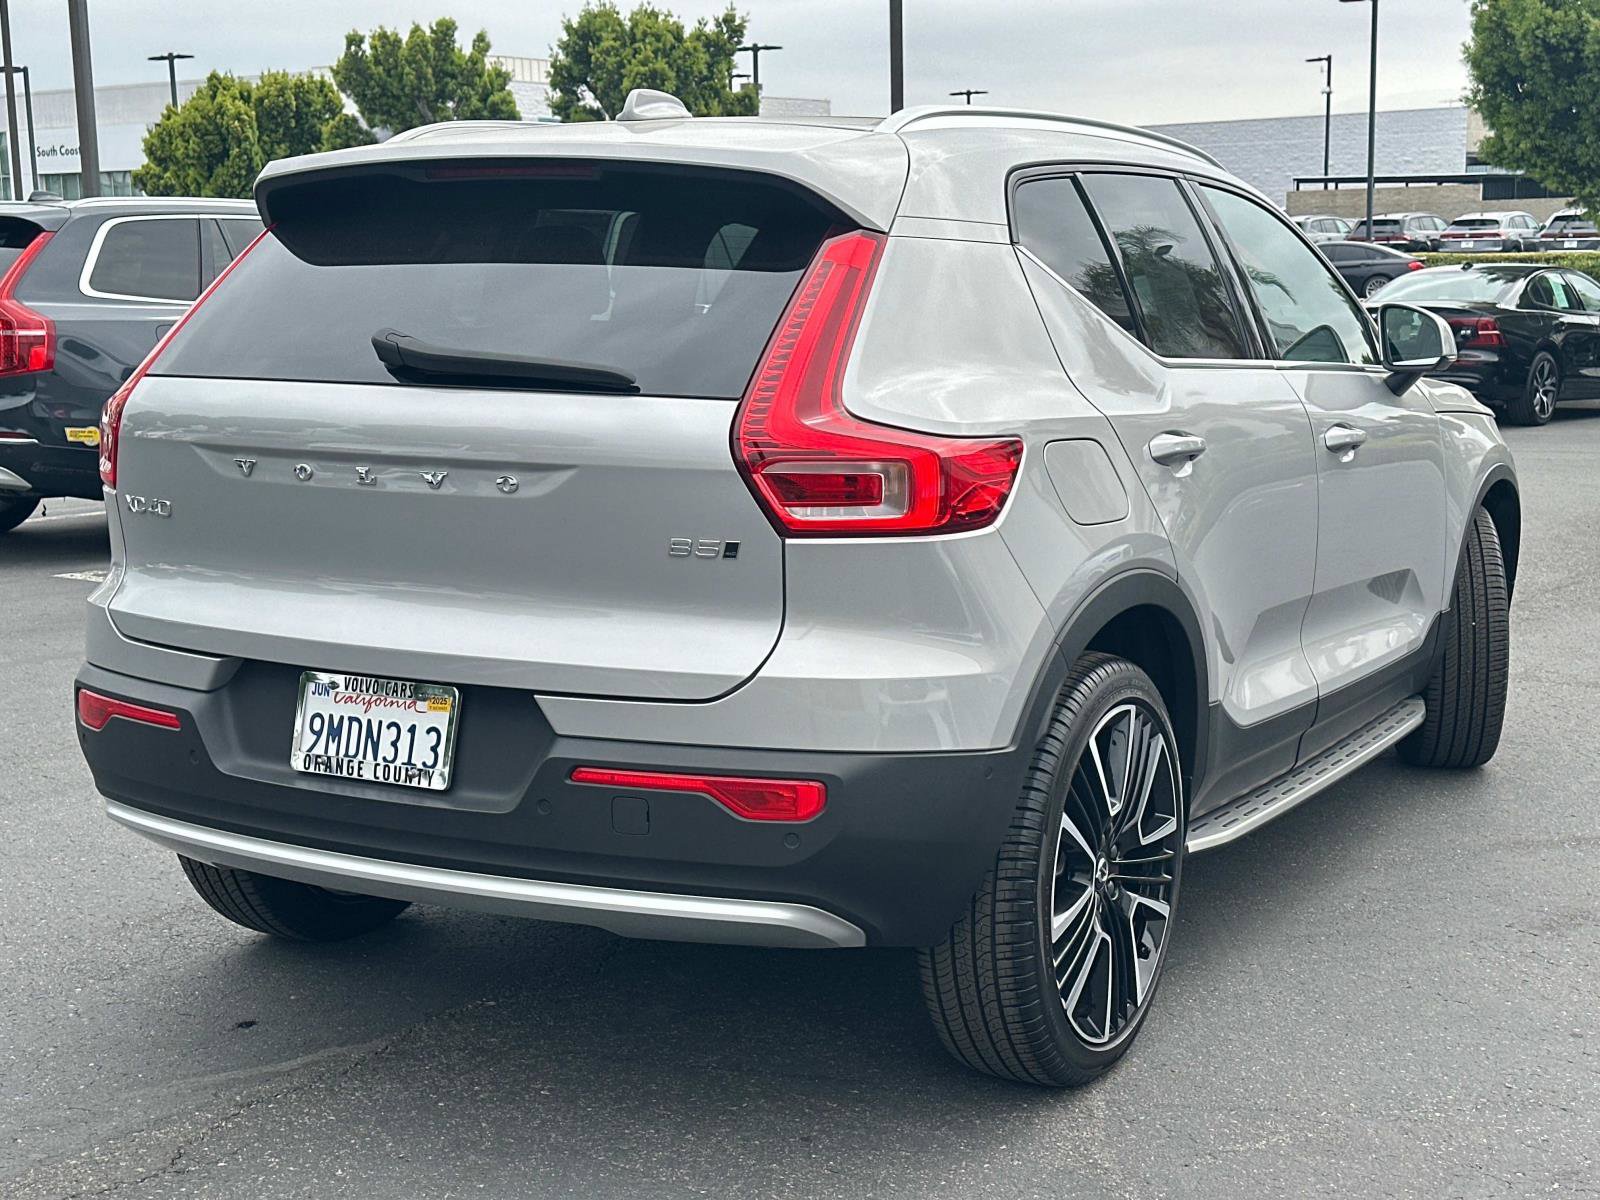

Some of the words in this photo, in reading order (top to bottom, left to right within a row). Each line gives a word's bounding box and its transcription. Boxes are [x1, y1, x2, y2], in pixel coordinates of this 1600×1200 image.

[36, 145, 58, 157] South
[59, 144, 80, 156] Coas
[233, 458, 519, 495] VOLVO
[125, 494, 171, 517] XC40
[668, 537, 721, 558] B5
[311, 682, 330, 697] JUN
[344, 676, 379, 695] VOLVO
[384, 681, 414, 699] CARS
[333, 690, 428, 714] California
[431, 696, 449, 705] 2025
[306, 712, 442, 769] 9MDN313
[303, 753, 365, 778] ORANGE
